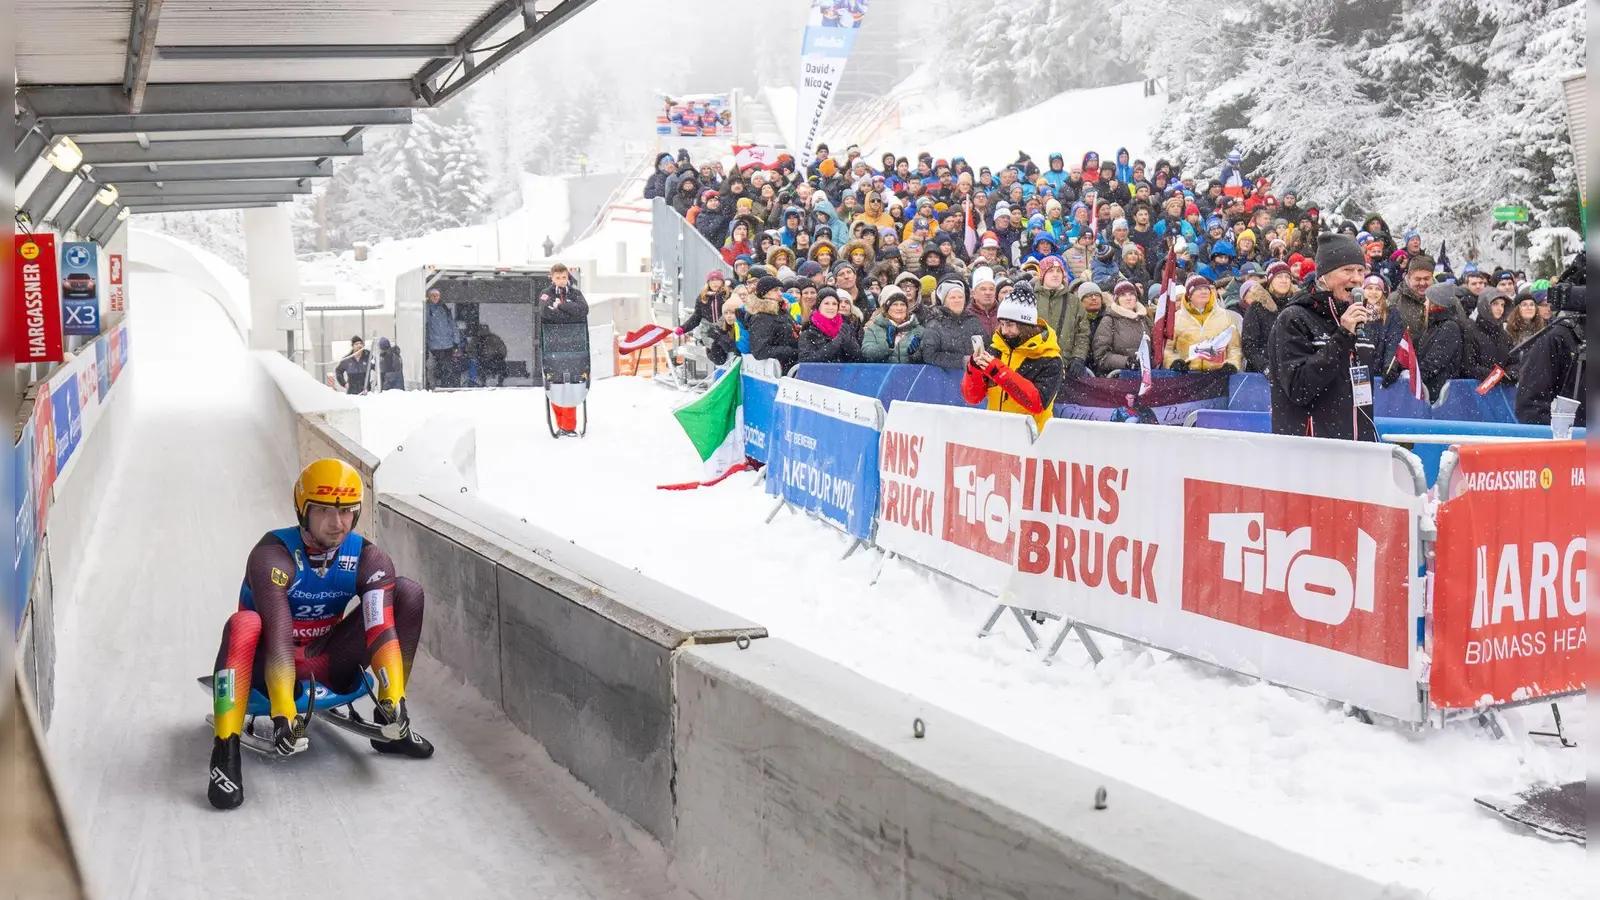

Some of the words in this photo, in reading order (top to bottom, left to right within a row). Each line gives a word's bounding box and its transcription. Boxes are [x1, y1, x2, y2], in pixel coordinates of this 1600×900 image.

[805, 63, 830, 74] David
[804, 77, 822, 88] Nico
[23, 263, 47, 358] HARGASSNER
[65, 305, 96, 324] X3
[316, 486, 357, 497] DHL
[807, 464, 832, 504] YOUR
[1022, 457, 1129, 525] INNS'
[1017, 520, 1159, 604] BRUCK
[1208, 512, 1377, 626] Tirol
[295, 604, 327, 617] 23
[211, 766, 238, 793] STS
